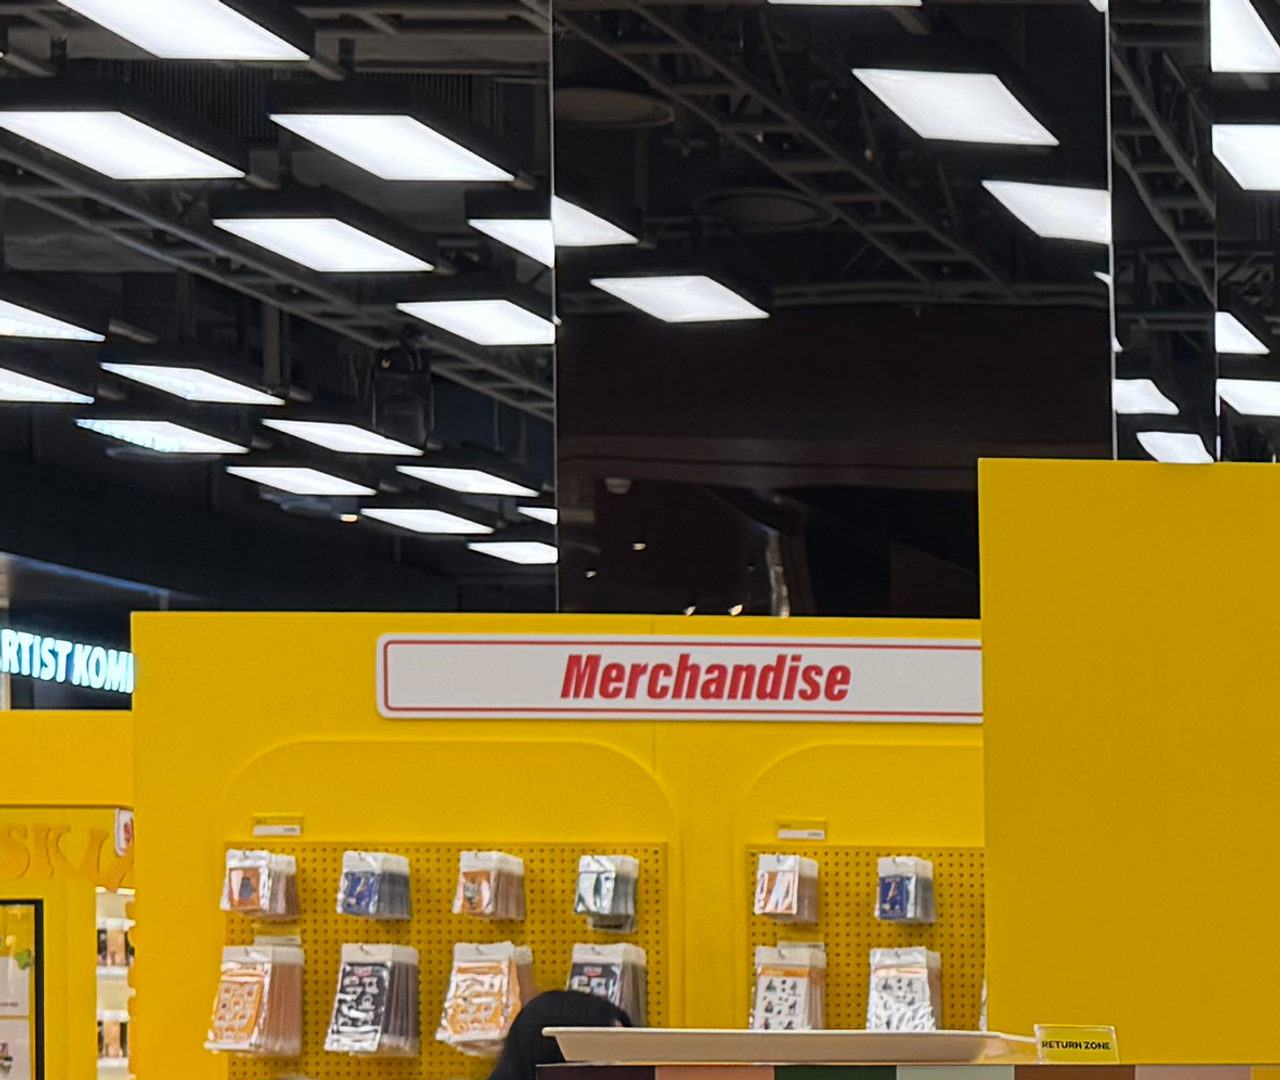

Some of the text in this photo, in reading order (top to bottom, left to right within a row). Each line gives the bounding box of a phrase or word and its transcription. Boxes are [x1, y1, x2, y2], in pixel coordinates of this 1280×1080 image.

[0, 629, 73, 683] RTIST
[561, 653, 851, 701] Merchandise
[1042, 1040, 1111, 1050] RETURN ZONE
